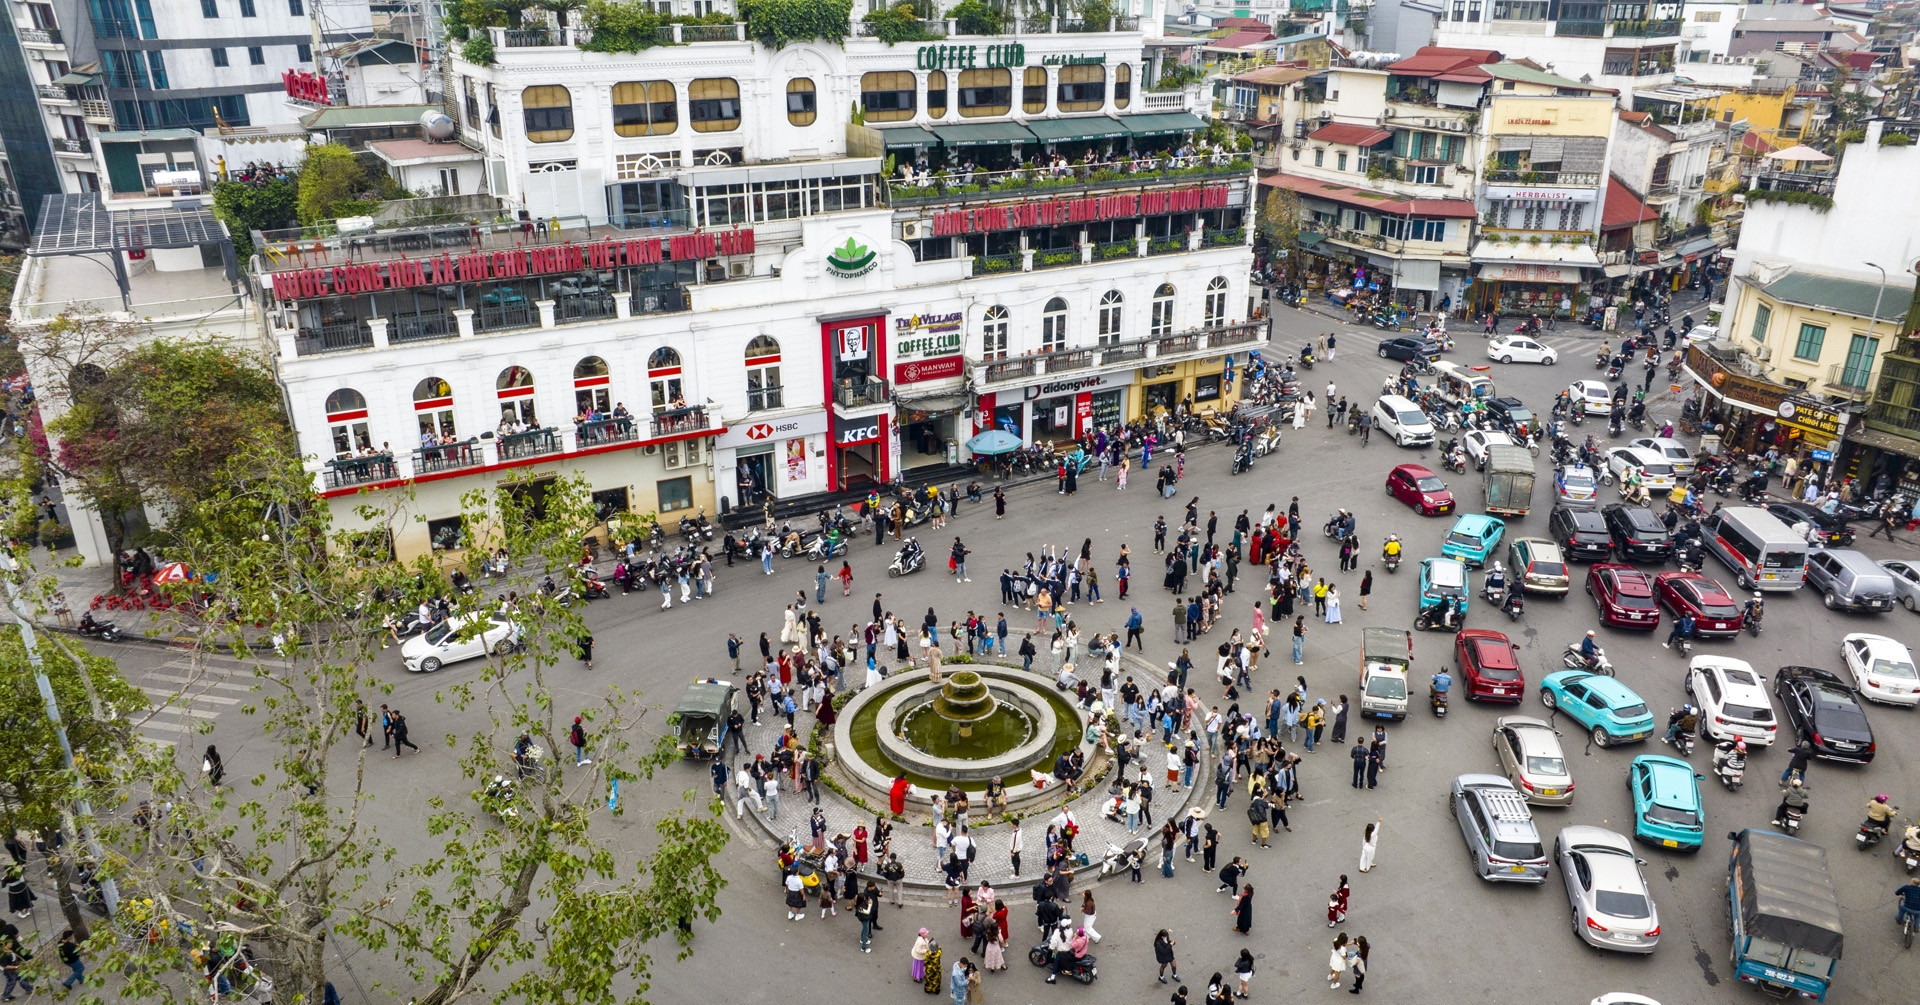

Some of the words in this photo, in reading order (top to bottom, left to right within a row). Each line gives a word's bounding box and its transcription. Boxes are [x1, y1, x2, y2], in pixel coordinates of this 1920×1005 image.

[917, 44, 977, 70] COFFEE
[986, 43, 1025, 68] CLUB
[1069, 52, 1106, 66] Restaurant
[1516, 191, 1567, 199] HERBALIST
[933, 203, 970, 237] ĐẢNG
[974, 200, 1009, 236] CỘNG
[1012, 196, 1039, 228] SẢN
[1041, 195, 1067, 228] VIỆT
[1068, 197, 1097, 222] NAM
[1098, 193, 1138, 221] QUANG
[1140, 191, 1167, 215] VINH
[1168, 184, 1201, 213] MUÔN
[1202, 181, 1229, 209] NĂM
[332, 257, 385, 299] CỘNG
[388, 252, 427, 289] HÒA
[430, 249, 456, 284] XÃ
[458, 246, 489, 287] HỘI
[493, 240, 528, 279] CHỦ
[531, 239, 584, 275] NGHĨA
[588, 235, 623, 273] VIỆT
[626, 237, 663, 266] NAM
[670, 226, 717, 262] MUÔN
[721, 223, 755, 257] NĂM
[825, 261, 878, 279] PHYTOPHARCO
[898, 337, 934, 354] COFFEE
[936, 333, 960, 348] CLUB
[921, 362, 956, 372] MANWAH
[1795, 405, 1814, 417] PATE
[1813, 410, 1829, 420] CT
[775, 422, 799, 433] HSBC
[1797, 415, 1819, 427] CHÍNH
[1820, 421, 1837, 432] HIỆU
[843, 425, 878, 444] KFC
